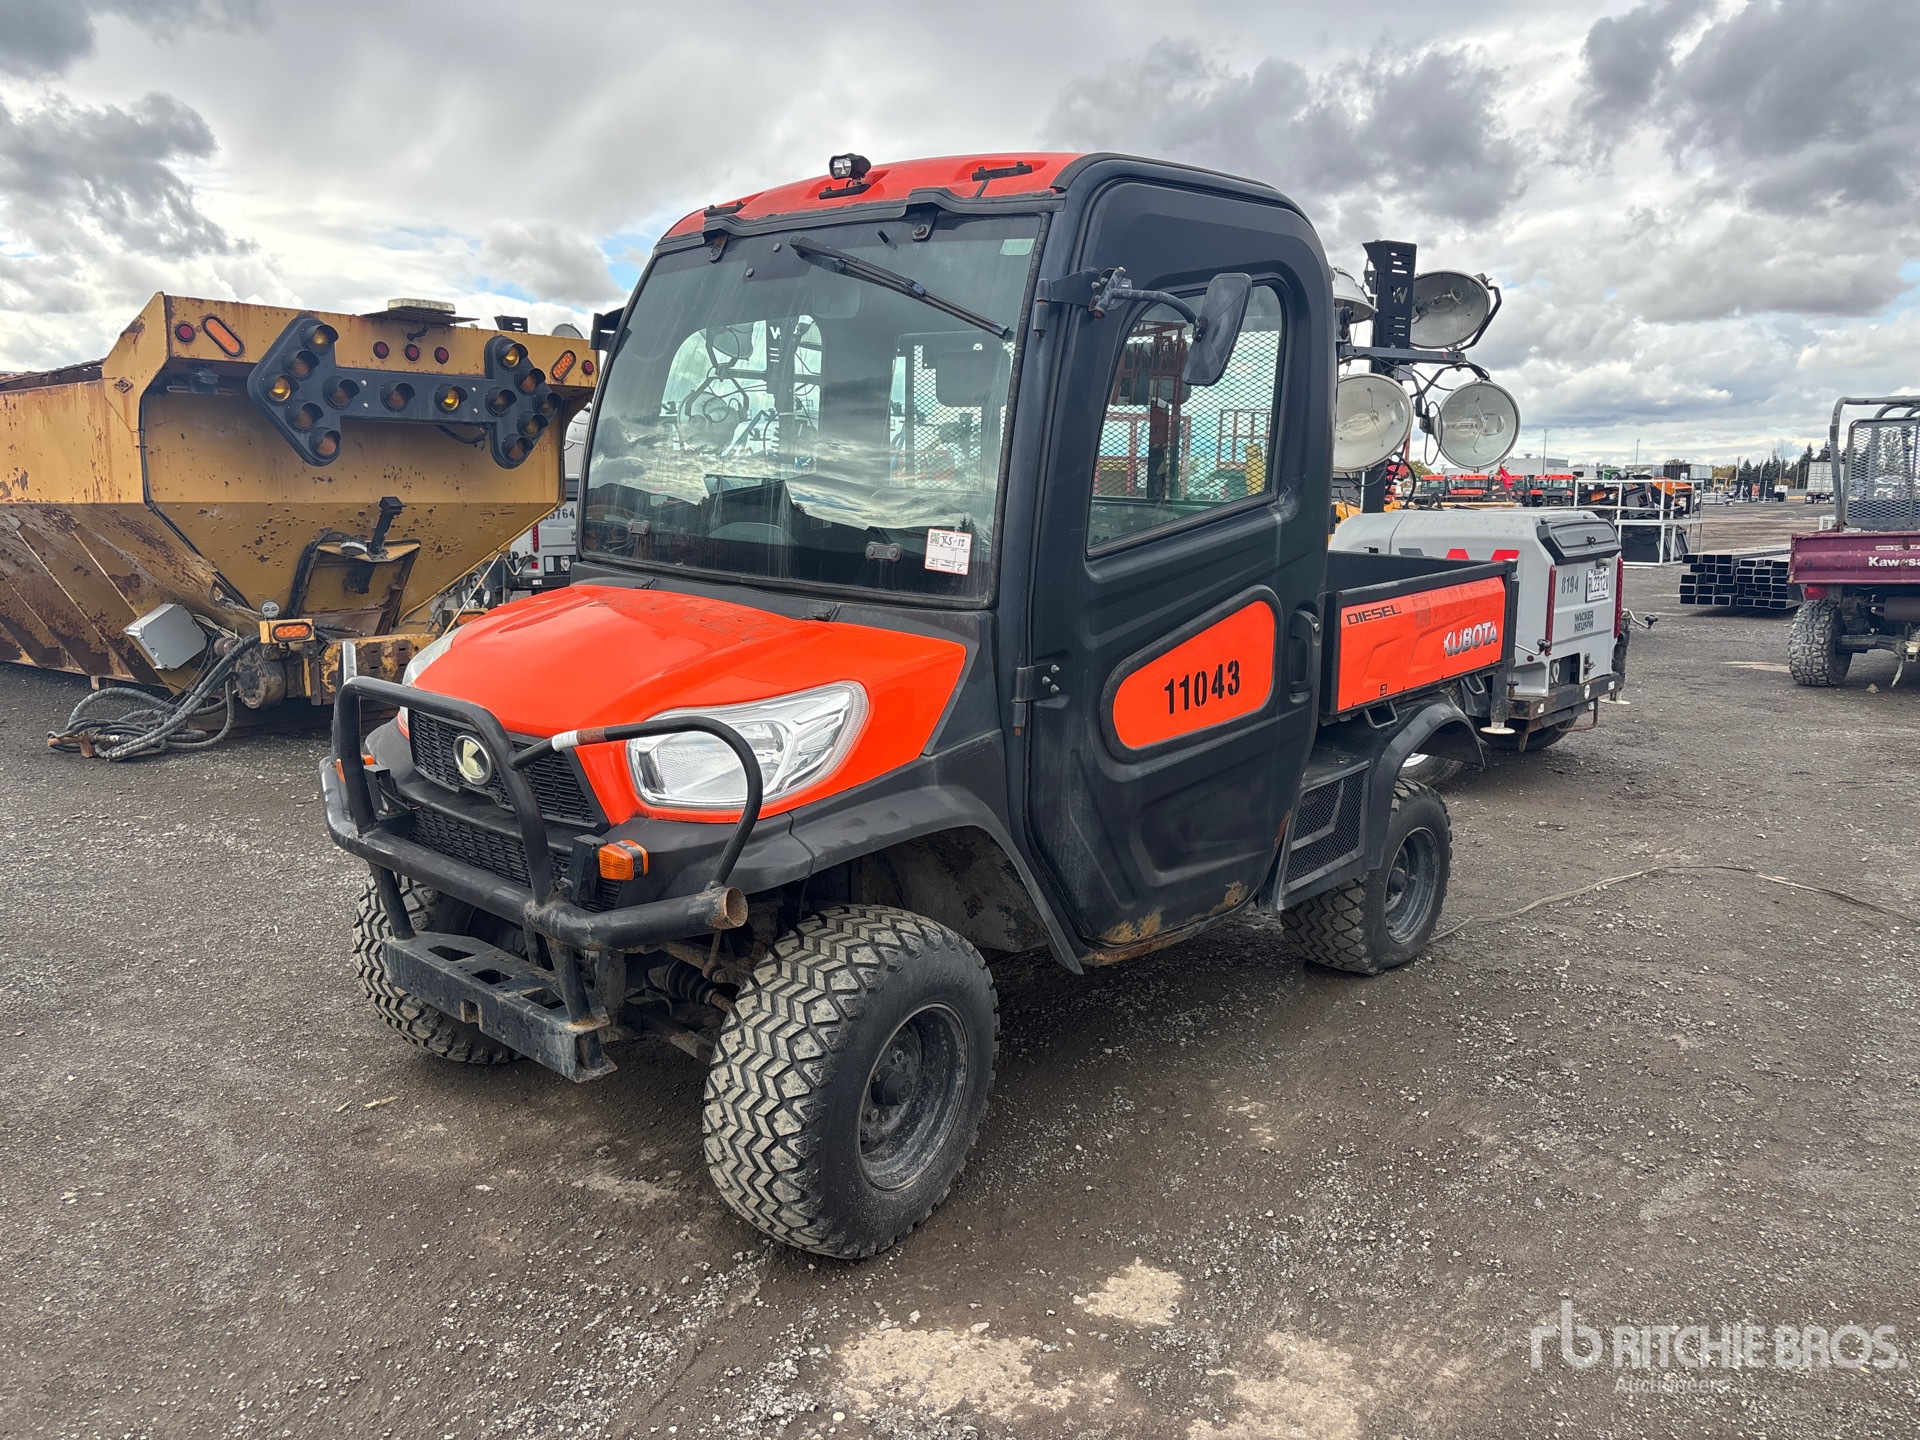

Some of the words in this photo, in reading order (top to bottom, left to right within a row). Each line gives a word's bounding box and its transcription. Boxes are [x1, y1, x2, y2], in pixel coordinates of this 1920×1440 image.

[1561, 576, 1579, 594] 8194
[1346, 605, 1402, 625] DIESEL
[1574, 610, 1594, 622] WACKER
[1574, 620, 1594, 632] NEUSON
[1443, 620, 1498, 657] KUBOTA
[1164, 660, 1240, 715] 11043
